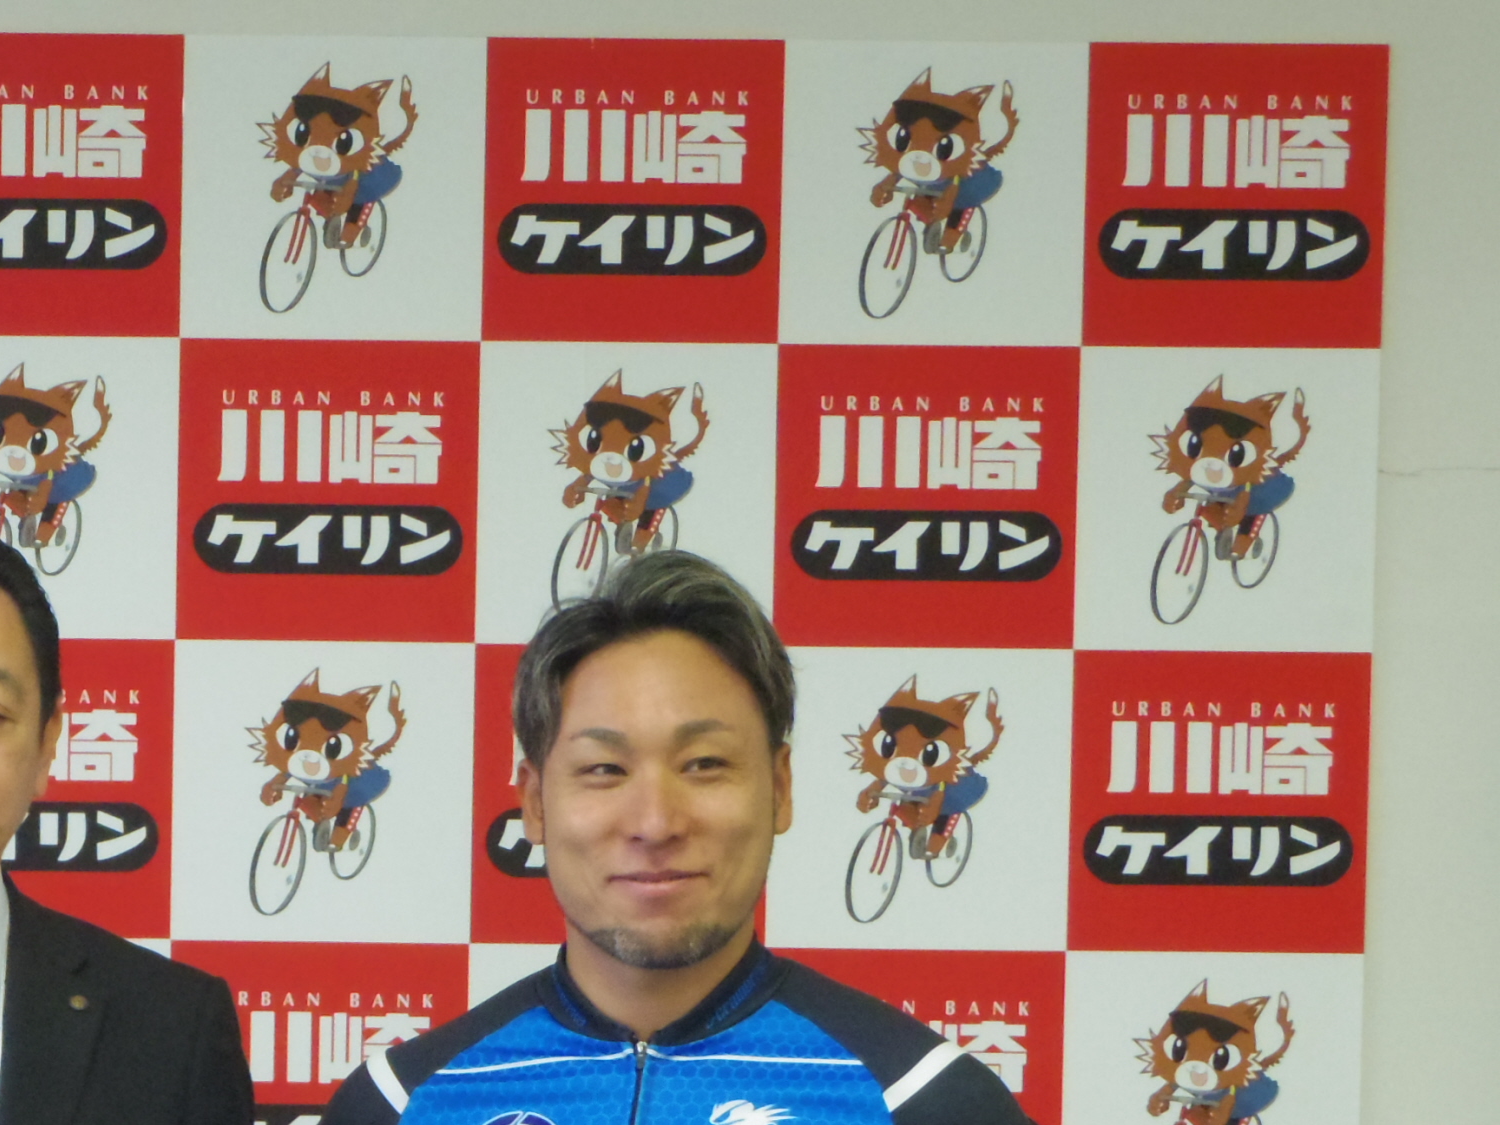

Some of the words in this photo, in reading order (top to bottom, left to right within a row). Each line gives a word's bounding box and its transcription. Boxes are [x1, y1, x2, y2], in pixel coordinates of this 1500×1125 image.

[65, 85, 147, 100] BANK
[527, 90, 633, 104] URBAN
[665, 91, 747, 105] BANK
[1129, 95, 1236, 109] URBAN
[1268, 96, 1351, 109] BANK
[522, 109, 746, 183] 川崎
[1124, 115, 1349, 188] 川崎
[511, 214, 754, 265] ケイリン
[1112, 219, 1357, 270] ケイリン
[223, 390, 329, 405] URBAN
[361, 391, 443, 406] BANK
[821, 396, 928, 411] URBAN
[960, 397, 1043, 412] BANK
[218, 410, 442, 484] 川崎
[816, 416, 1041, 489] 川崎
[208, 514, 450, 564] ケイリン
[805, 520, 1049, 570] ケイリン
[1113, 702, 1220, 716] URBAN
[1251, 703, 1334, 717] BANK
[56, 709, 138, 781] 崎
[1107, 722, 1332, 795] 川崎
[1096, 825, 1340, 875] ケイリン
[238, 991, 319, 1006] RBAN
[350, 993, 432, 1008] BANK
[946, 1001, 1028, 1016] BANK
